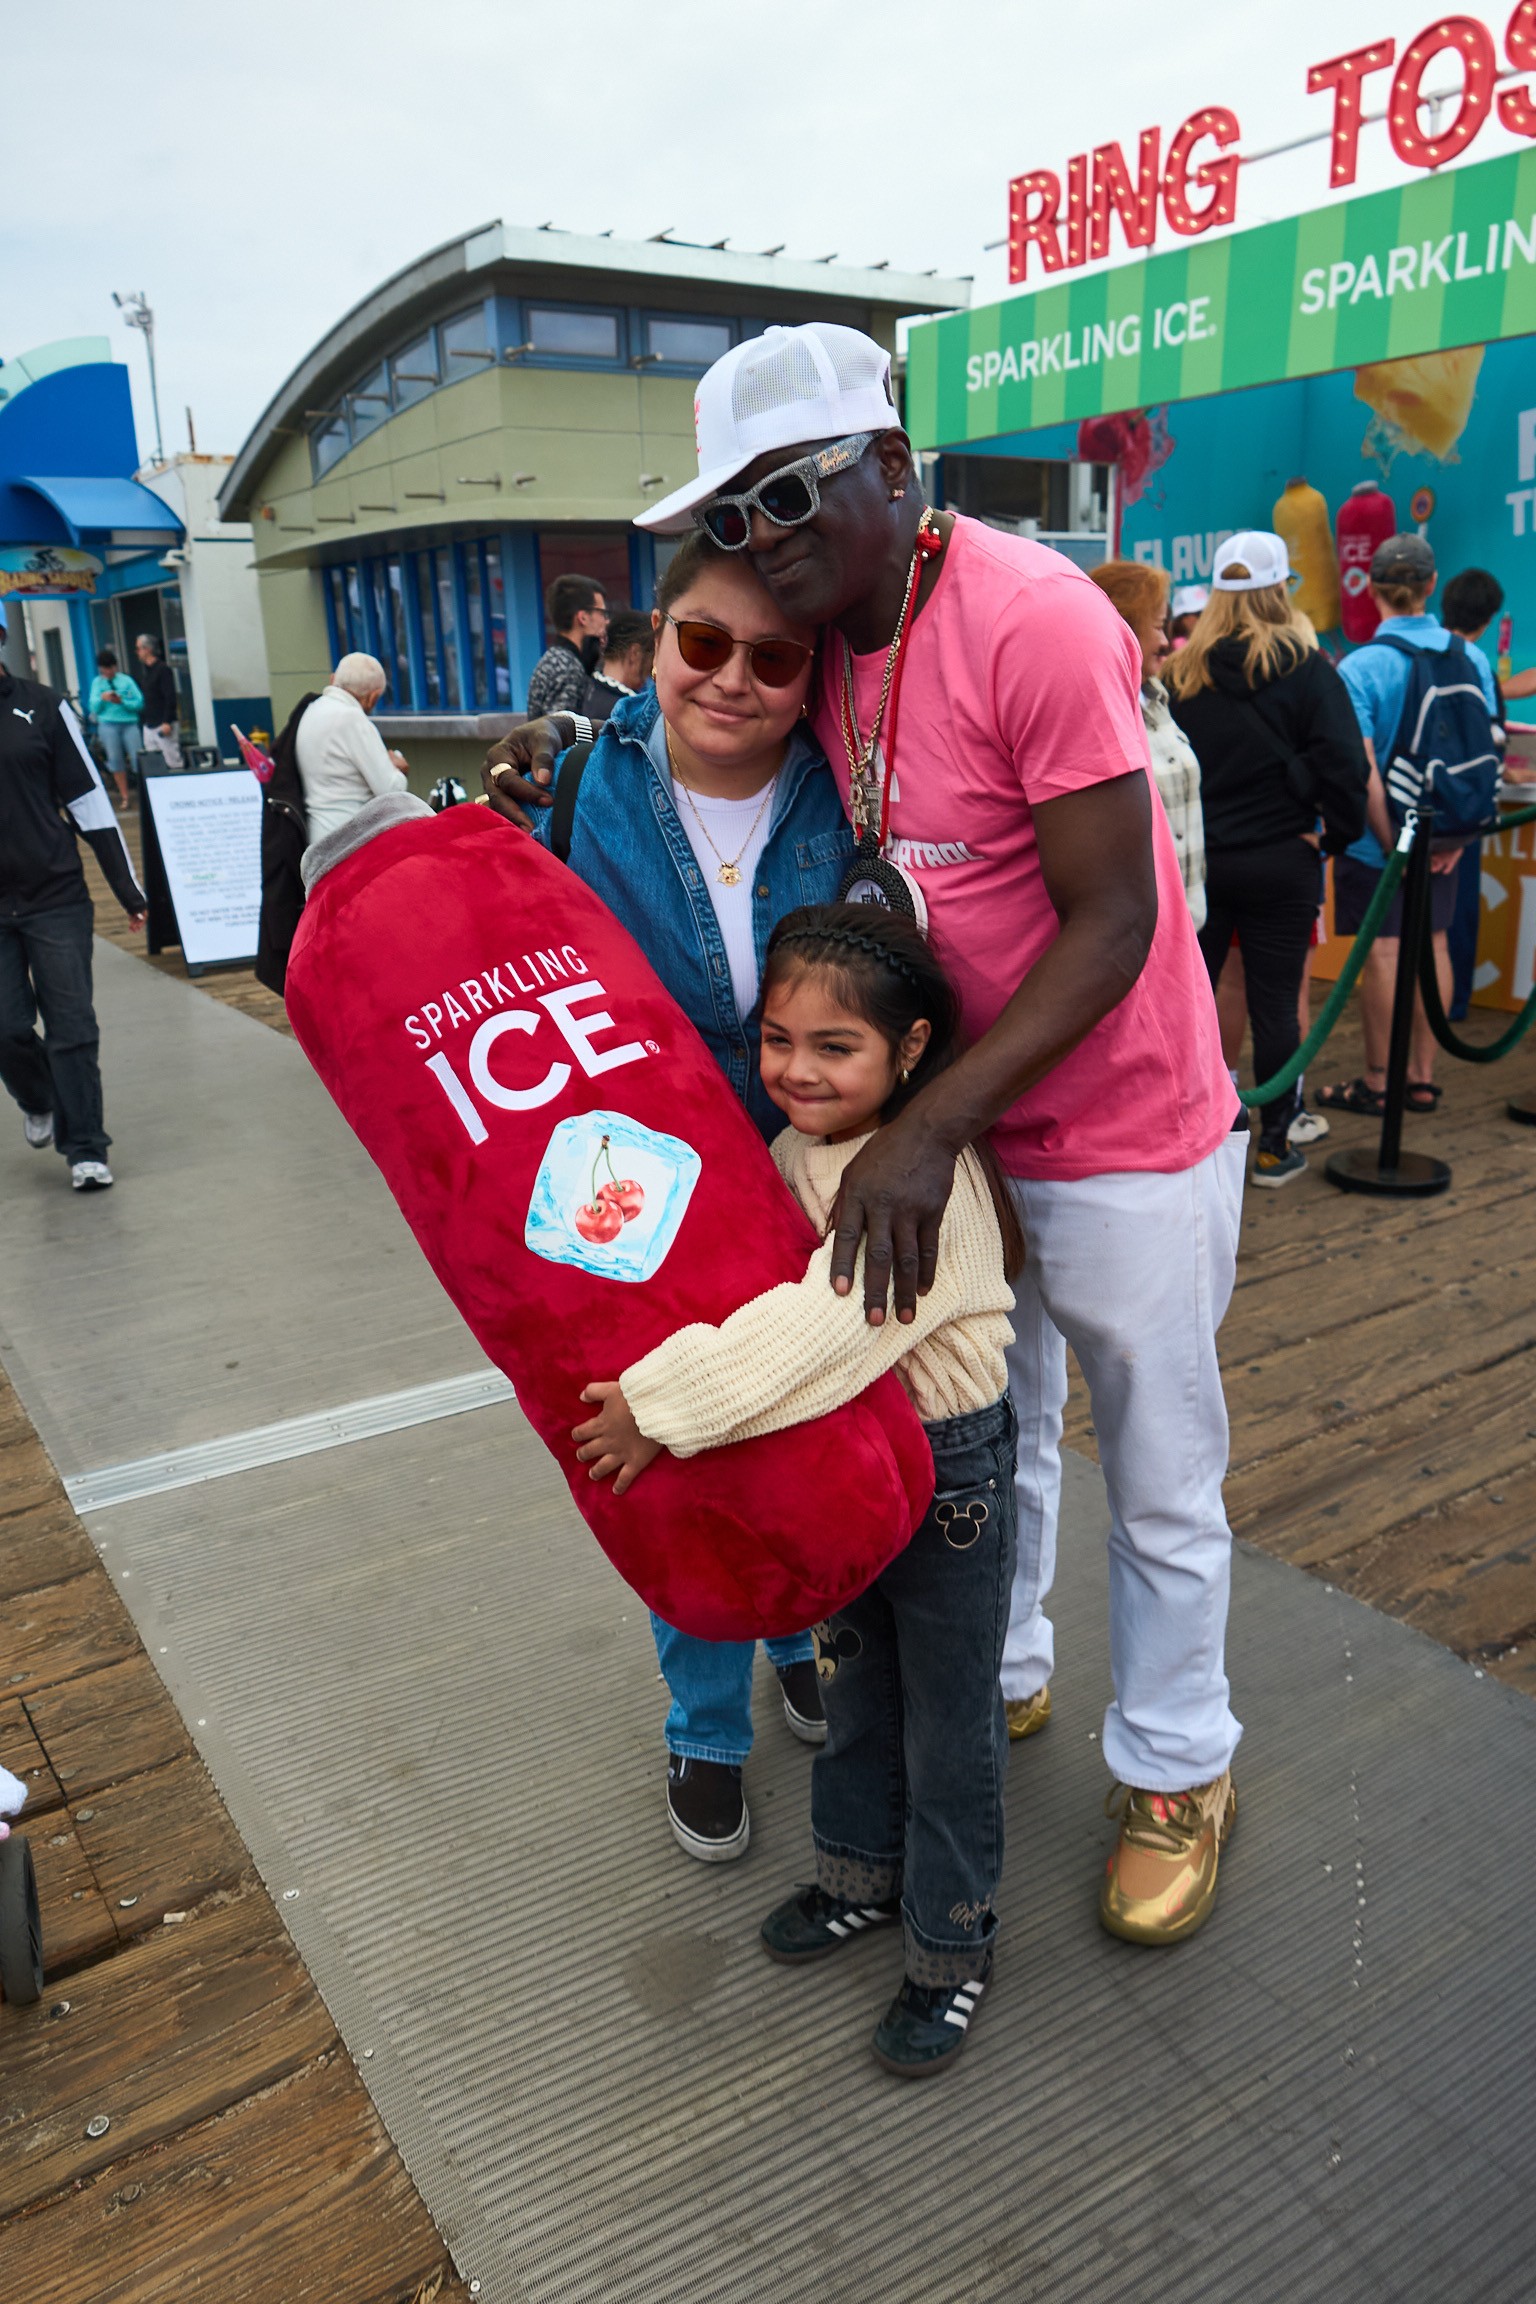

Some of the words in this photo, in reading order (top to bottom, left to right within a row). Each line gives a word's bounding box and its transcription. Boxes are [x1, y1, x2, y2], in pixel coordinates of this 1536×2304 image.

[1008, 105, 1241, 285] RING
[966, 314, 1141, 392] SPARKLING
[1134, 528, 1250, 582] FLAV
[404, 944, 589, 1051] SPARKLING
